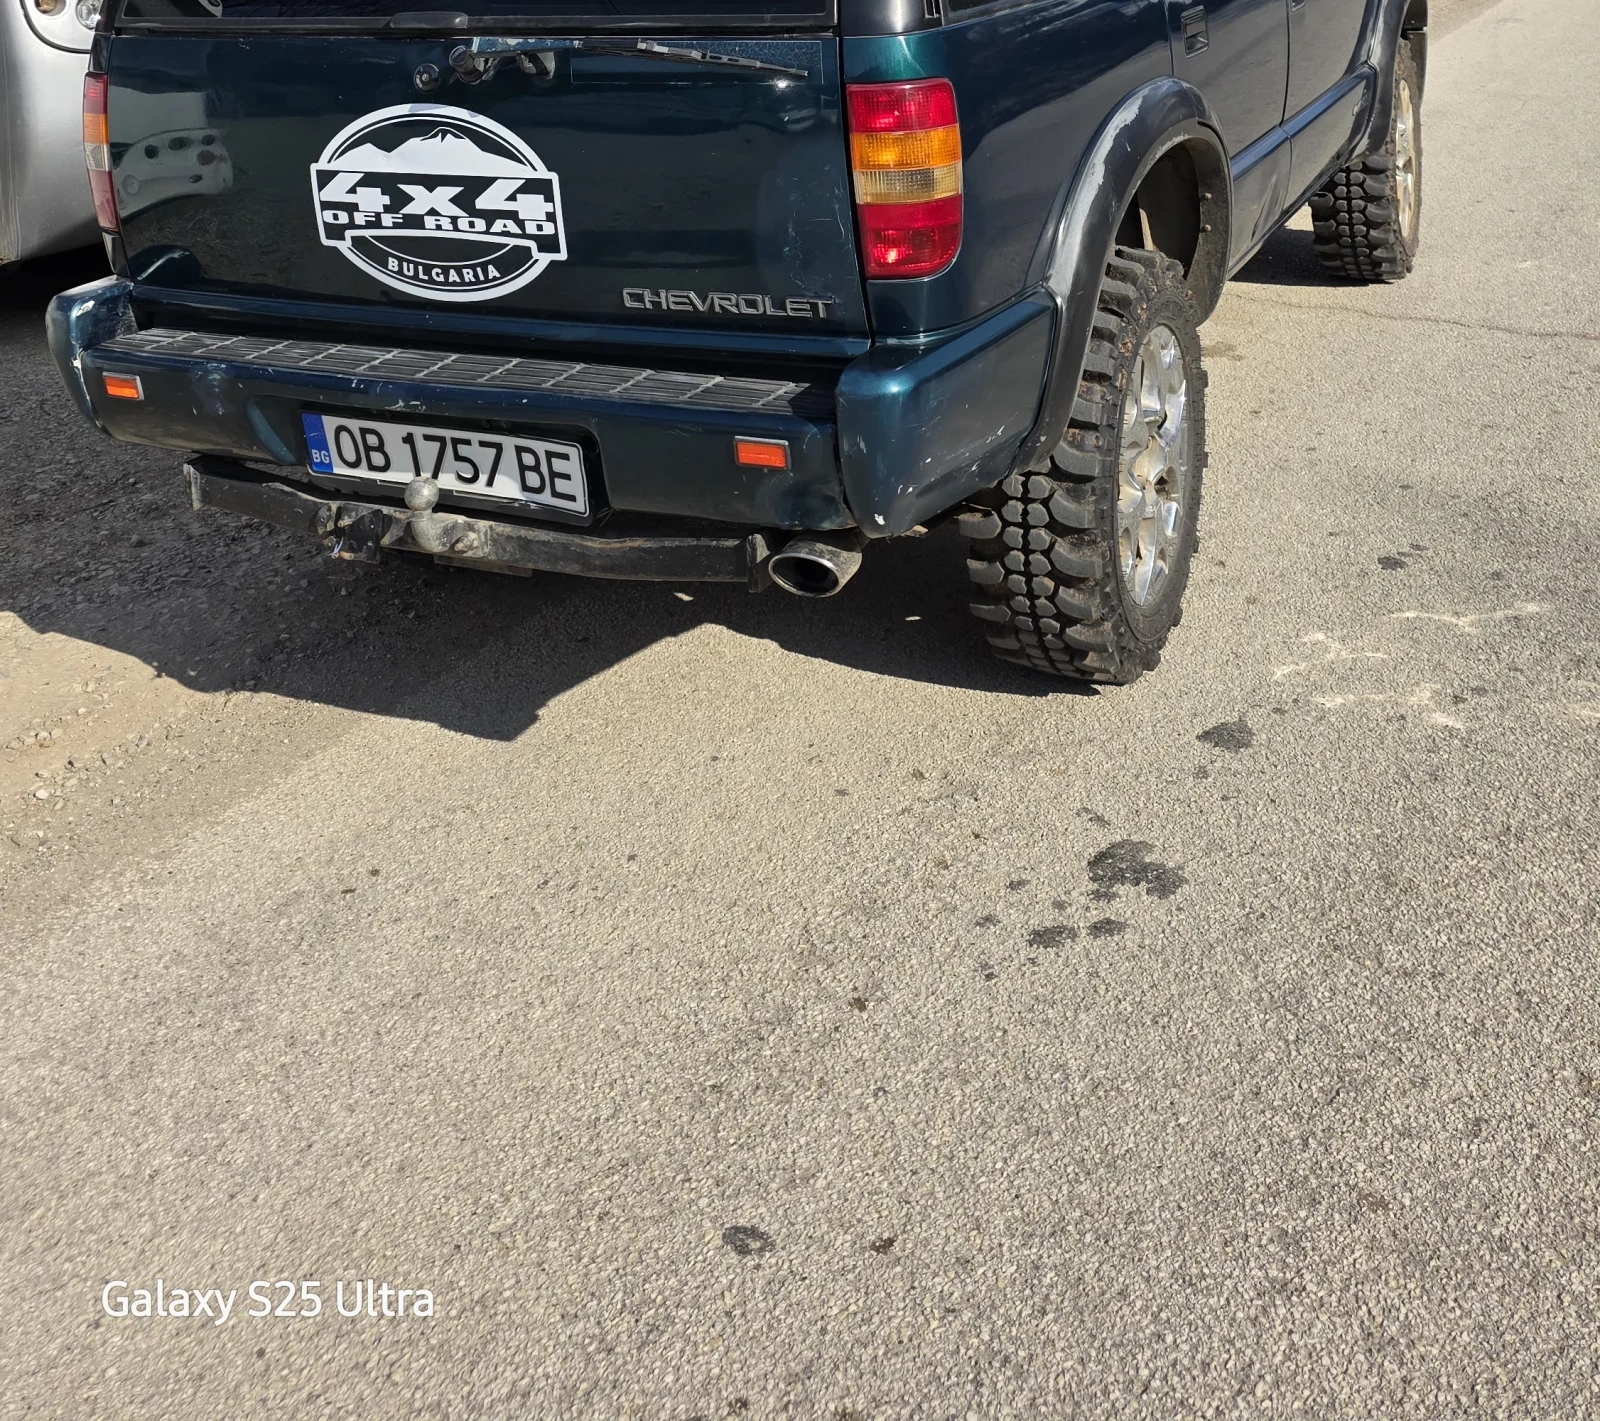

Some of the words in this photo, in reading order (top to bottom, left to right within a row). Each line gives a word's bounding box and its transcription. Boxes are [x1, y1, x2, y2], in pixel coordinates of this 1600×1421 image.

[322, 210, 404, 227] OFF
[423, 215, 556, 235] ROAD
[387, 256, 501, 283] BULGARIA
[622, 287, 835, 318] CHEVROLET
[311, 448, 330, 464] BG
[333, 424, 392, 473] OB
[401, 432, 504, 488] 1757
[514, 444, 577, 503] BE
